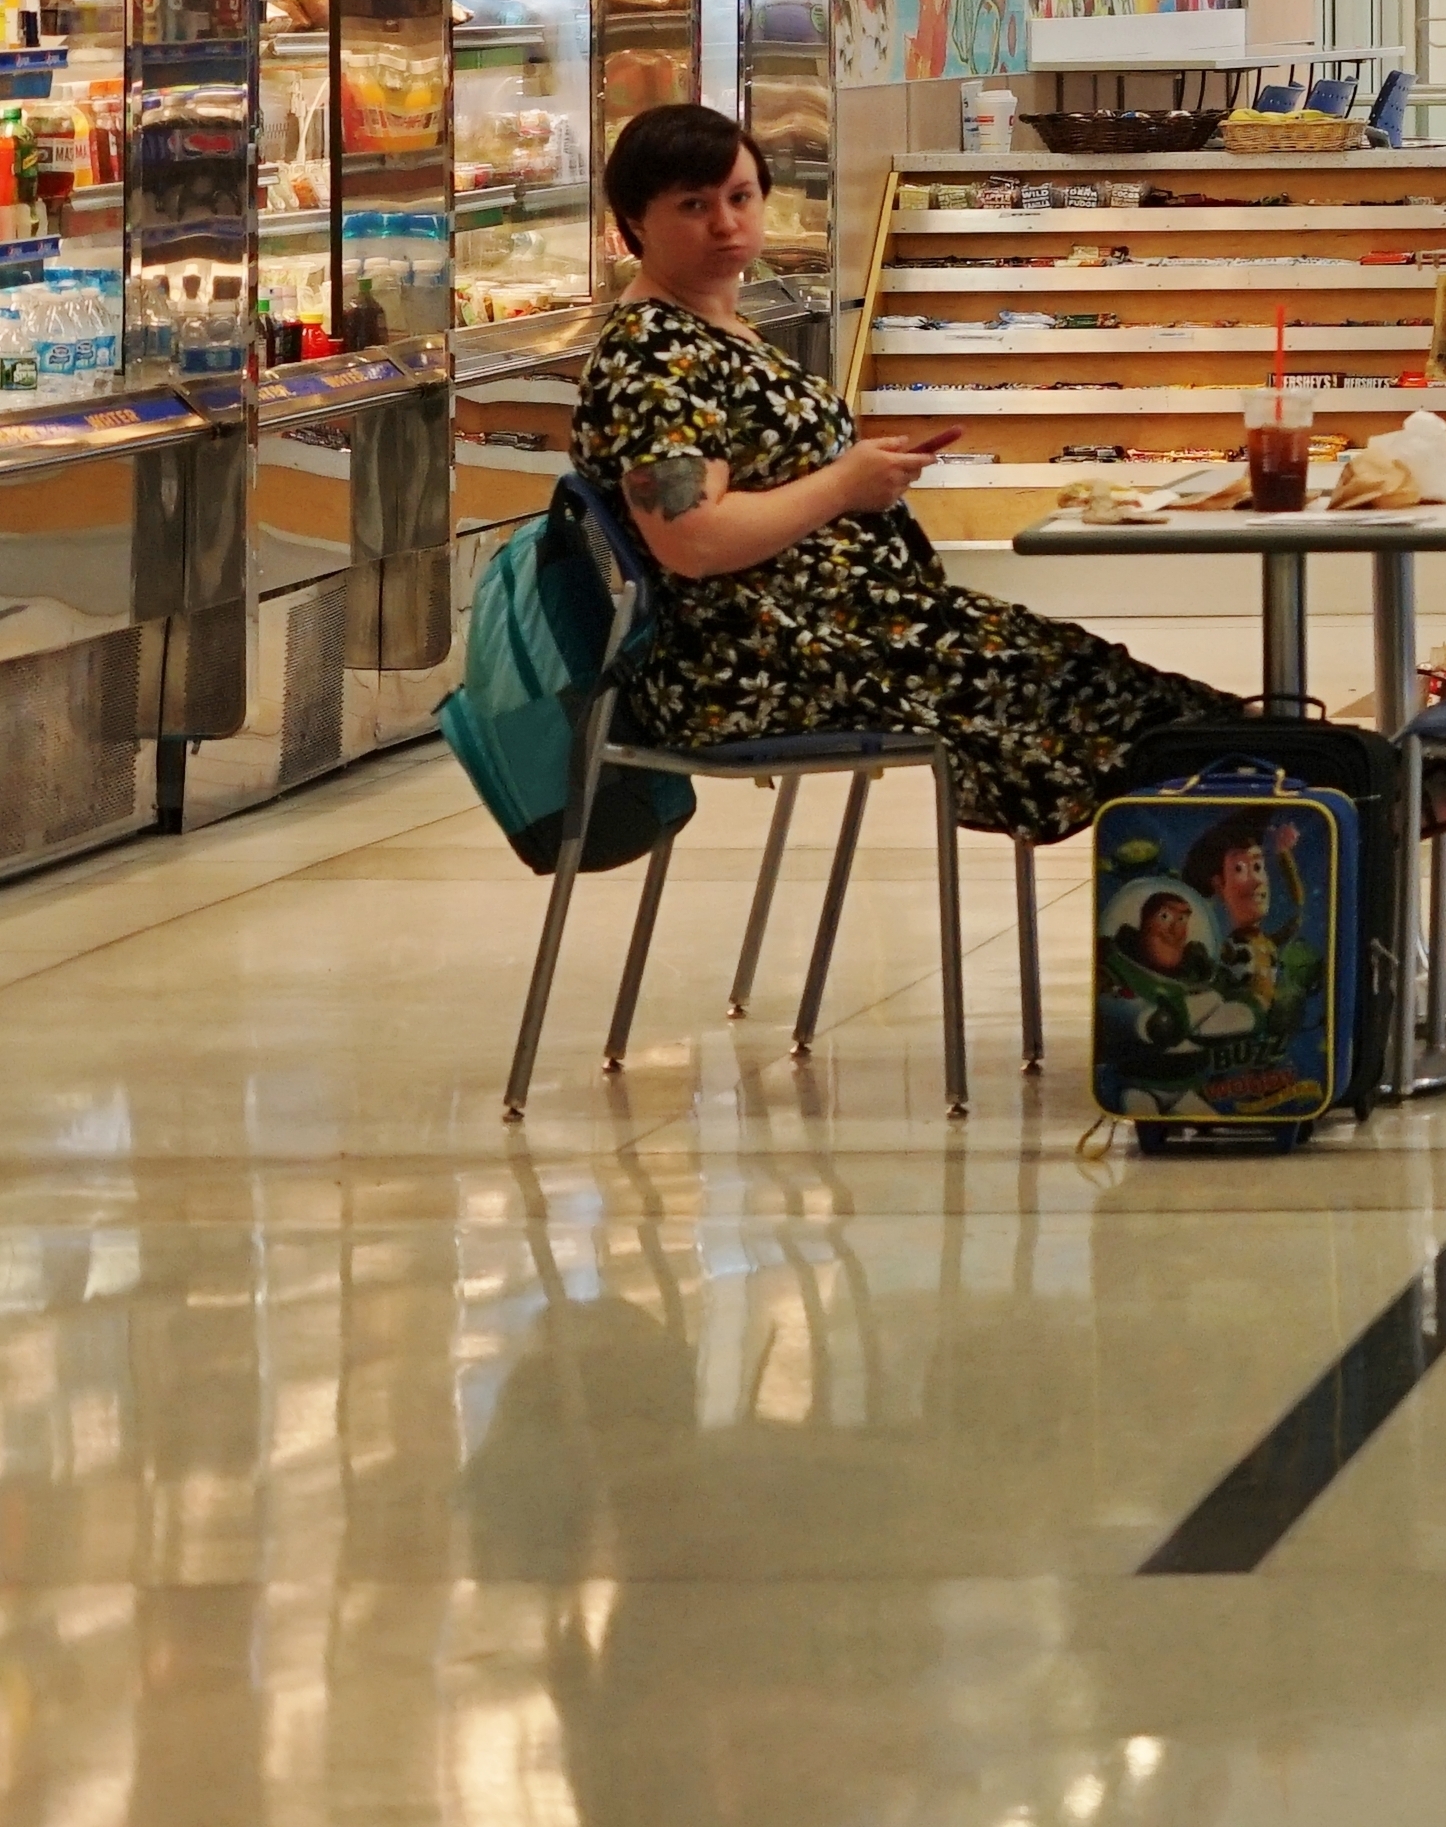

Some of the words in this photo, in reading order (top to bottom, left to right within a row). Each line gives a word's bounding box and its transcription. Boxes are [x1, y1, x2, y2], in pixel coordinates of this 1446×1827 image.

[1022, 189, 1049, 198] WILD
[1023, 200, 1051, 209] VANILLA
[1068, 200, 1096, 208] FUDGE
[1343, 377, 1391, 389] HERSHEY'S
[85, 408, 140, 430] WATER
